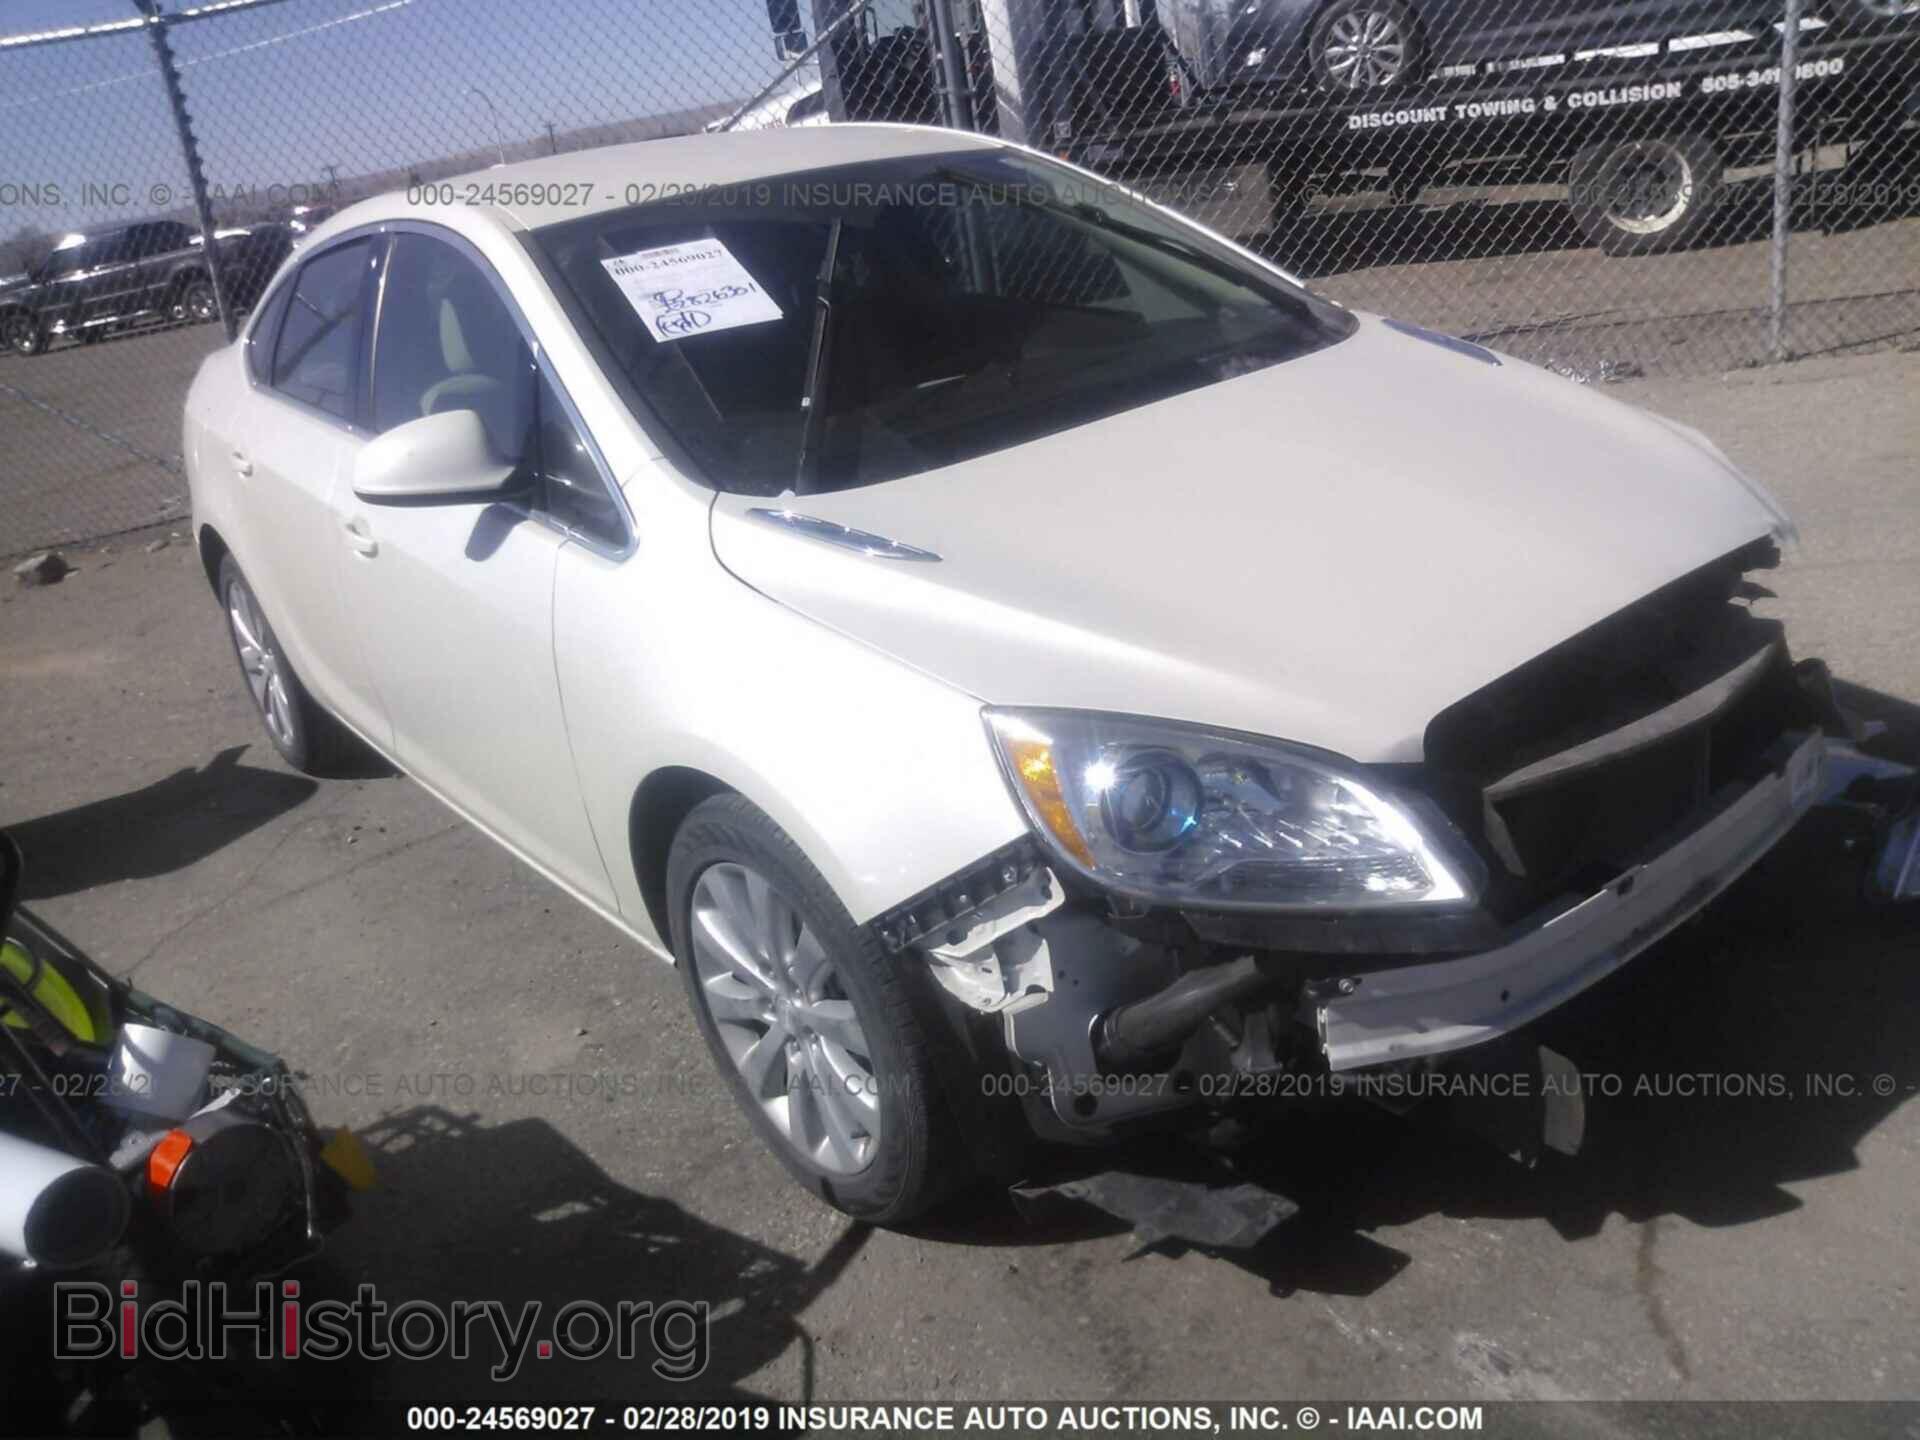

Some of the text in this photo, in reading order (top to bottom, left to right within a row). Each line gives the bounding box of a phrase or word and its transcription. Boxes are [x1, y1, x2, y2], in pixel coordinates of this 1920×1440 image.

[1348, 106, 1447, 130] DISCOUNT
[1455, 98, 1536, 120] TOWING
[1543, 95, 1558, 111] &
[1567, 81, 1682, 109] COLLISION
